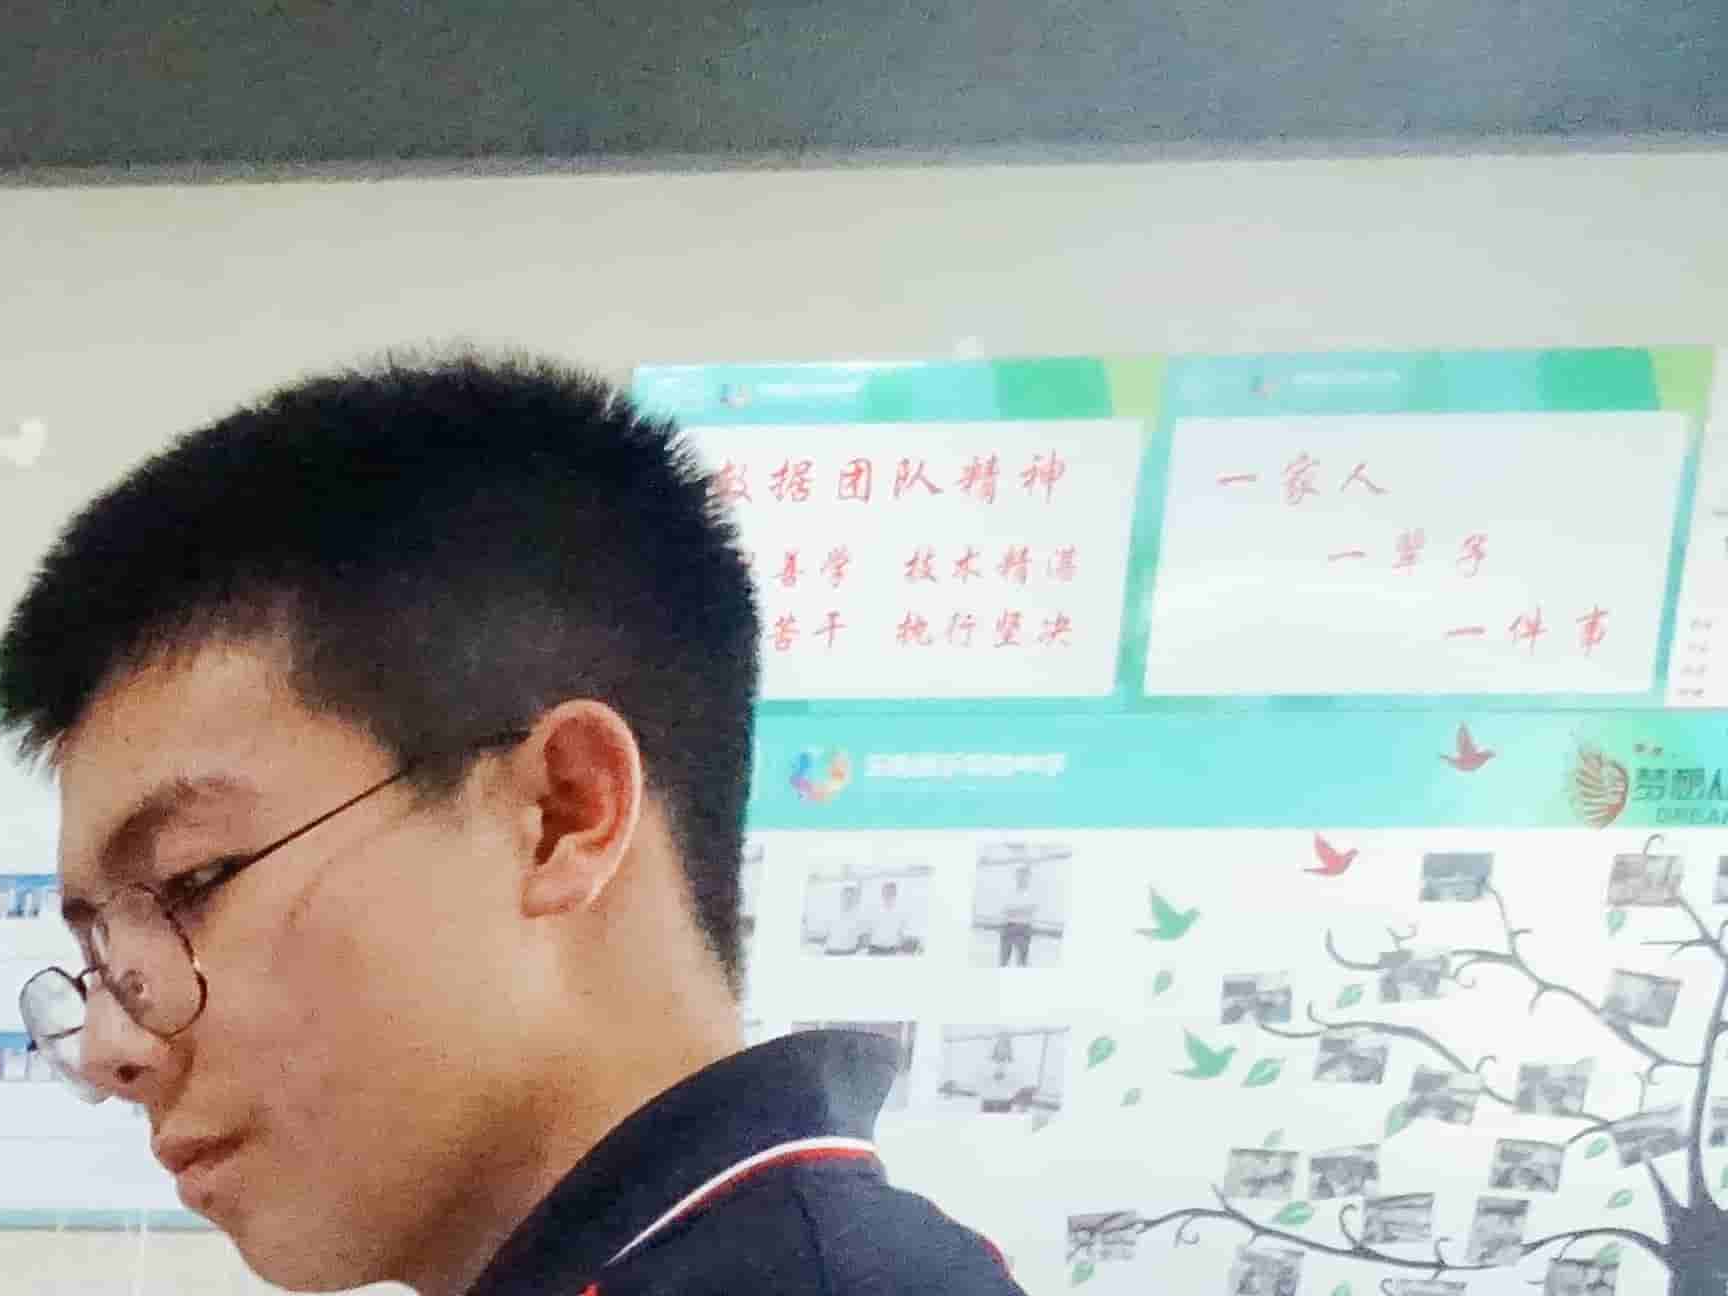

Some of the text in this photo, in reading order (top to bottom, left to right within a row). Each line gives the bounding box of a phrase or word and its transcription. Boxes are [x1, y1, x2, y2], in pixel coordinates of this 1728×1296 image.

[1216, 451, 1389, 505] 一家人
[1328, 528, 1488, 578] 一辈子
[894, 608, 1072, 648] 执行坚决
[1444, 605, 1609, 655] 一件事
